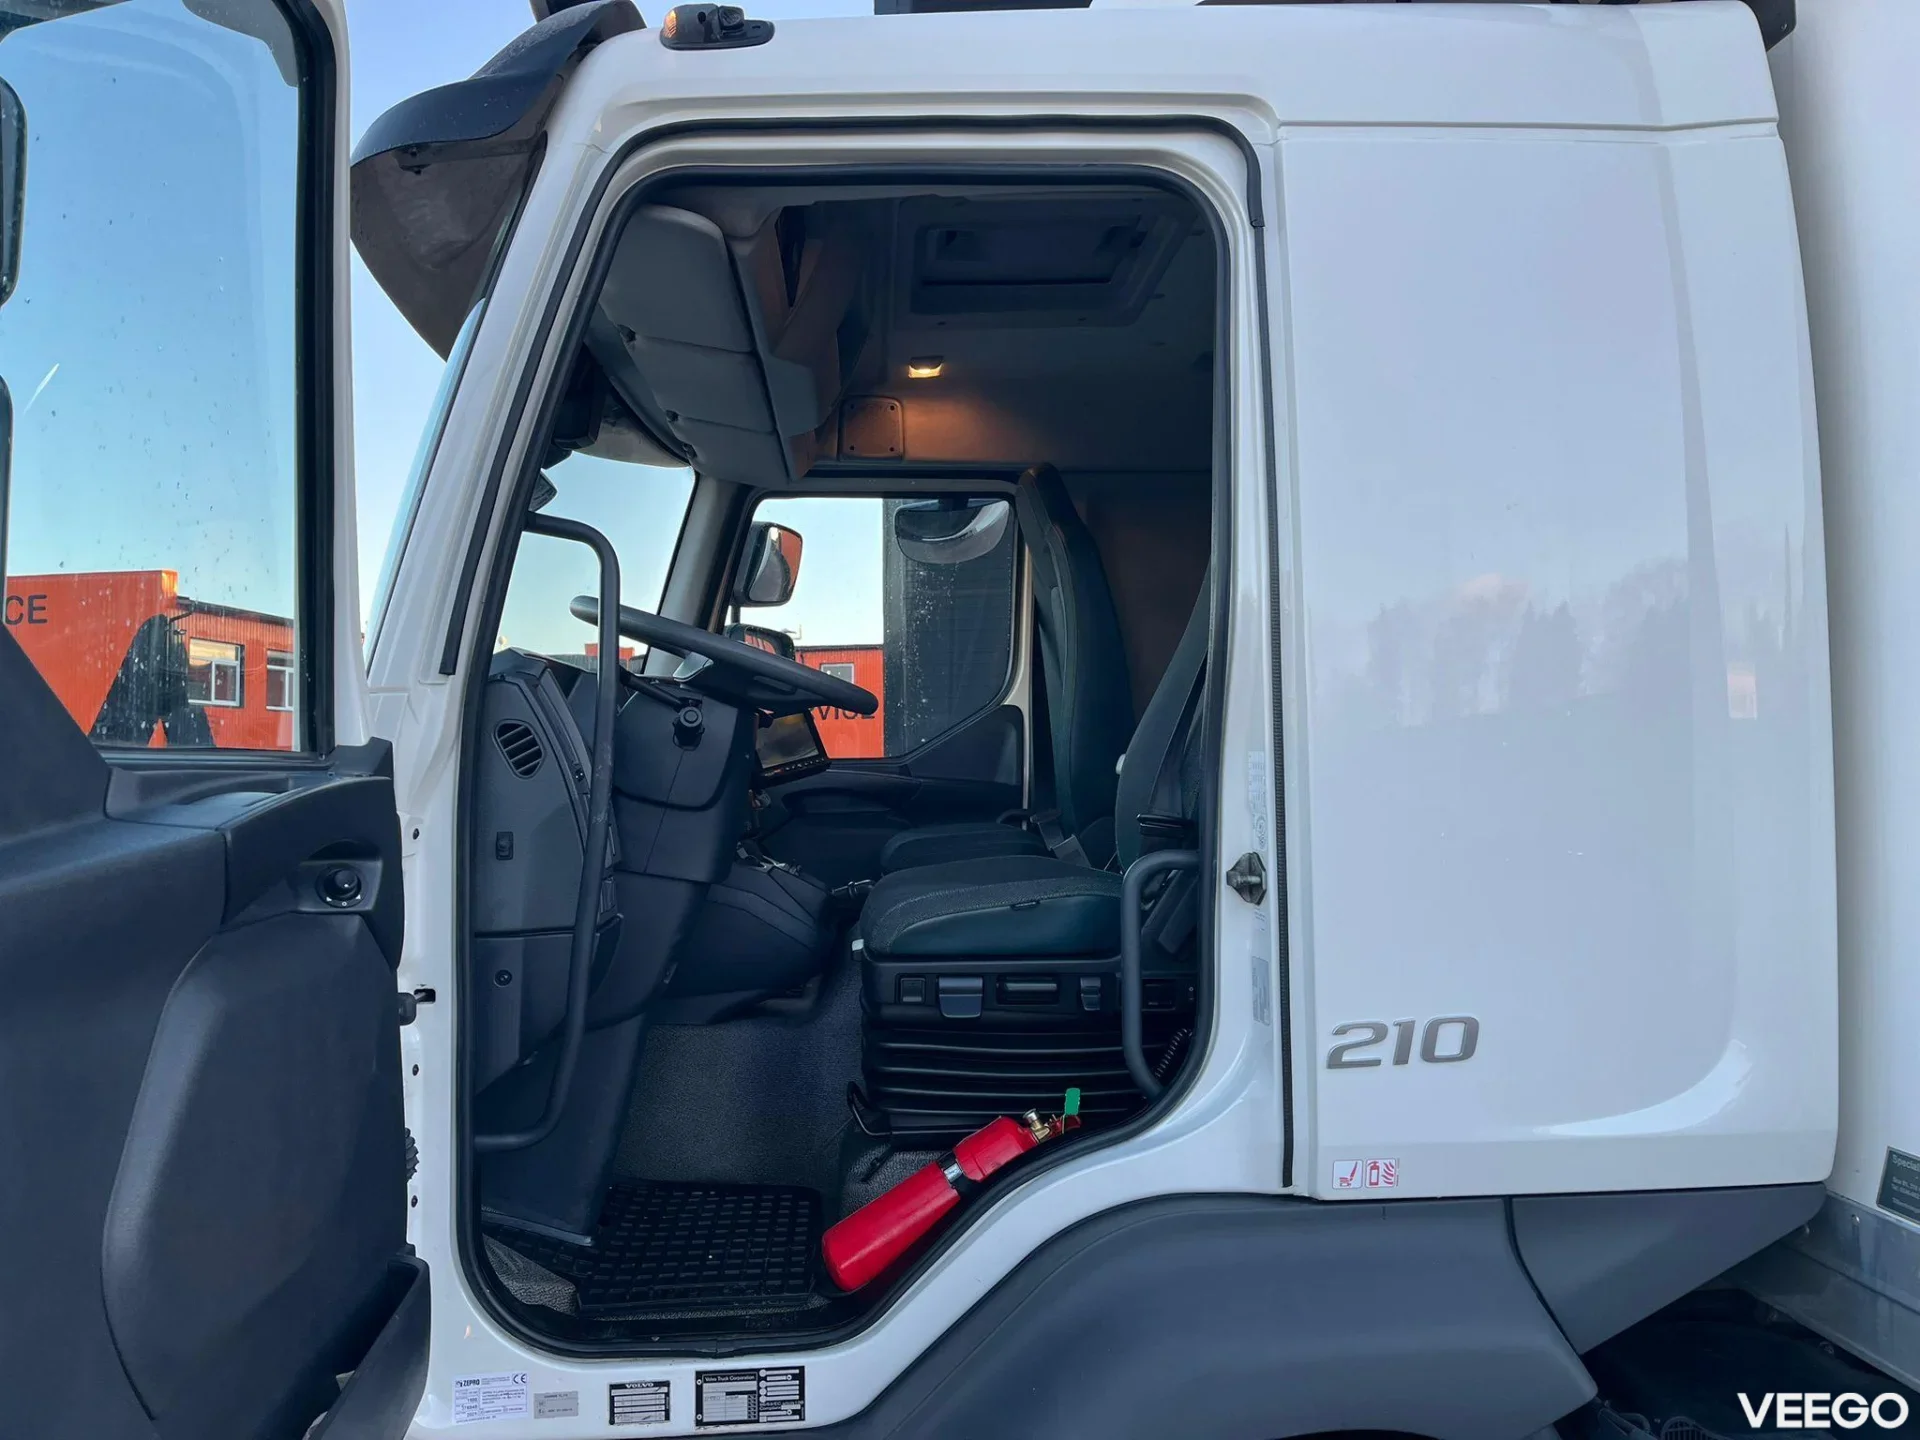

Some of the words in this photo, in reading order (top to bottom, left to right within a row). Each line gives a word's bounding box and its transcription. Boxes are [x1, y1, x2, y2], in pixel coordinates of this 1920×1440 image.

[817, 706, 875, 720] VI
[1326, 1014, 1480, 1069] 210
[463, 1379, 480, 1387] ZEPRO
